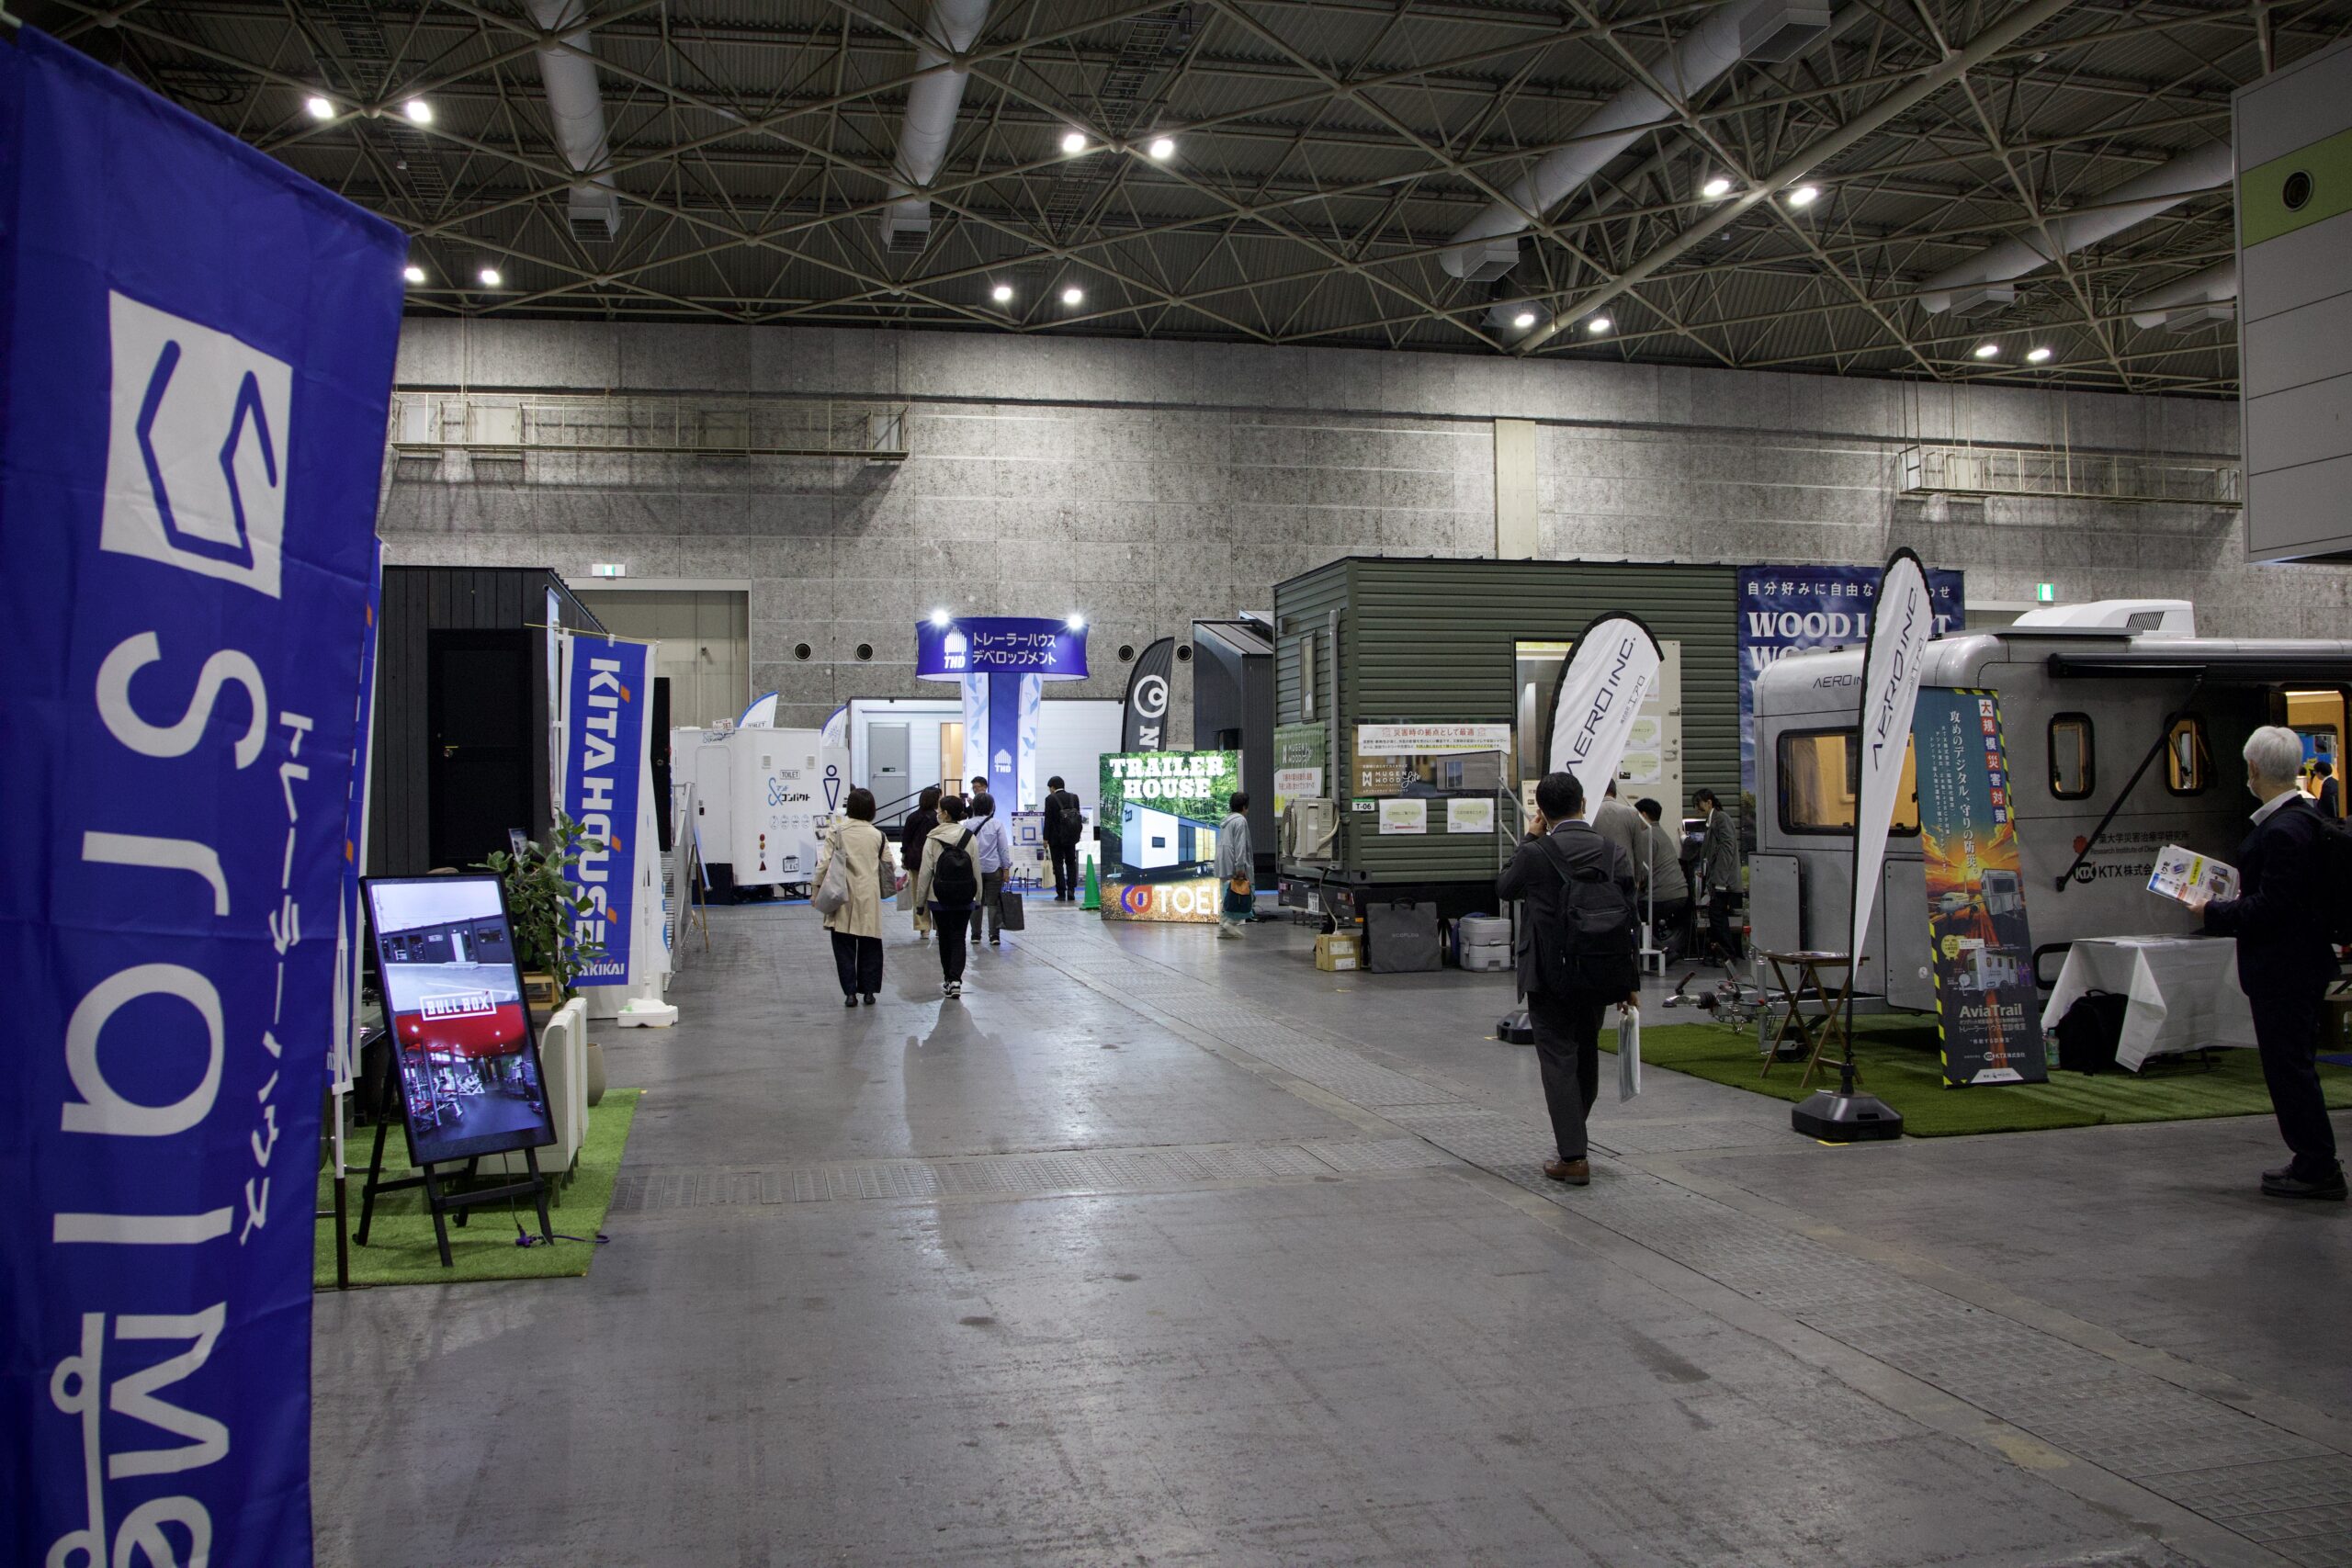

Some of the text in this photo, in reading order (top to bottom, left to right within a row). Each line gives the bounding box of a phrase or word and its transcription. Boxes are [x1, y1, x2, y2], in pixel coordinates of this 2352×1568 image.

[1747, 612, 1851, 637] WOOD
[973, 632, 1057, 648] トレーラーハウス
[944, 656, 966, 669] THD
[973, 650, 1057, 665] デベロップメント
[1813, 675, 1853, 690] AERO
[1394, 728, 1475, 736] 災害時の拠点として最適
[994, 764, 1012, 773] THD
[1109, 756, 1225, 778] TRAILER
[1981, 700, 2007, 823] 大規模災害対策
[1122, 778, 1212, 799] HOUSE
[781, 794, 810, 802] コンパクト
[2099, 863, 2154, 879] KTX株式会
[1154, 883, 1219, 915] TOEI
[239, 711, 314, 1247] トレーラーハウス
[425, 995, 491, 1015] BULL BOX
[1959, 1003, 2023, 1019] AviaTrail
